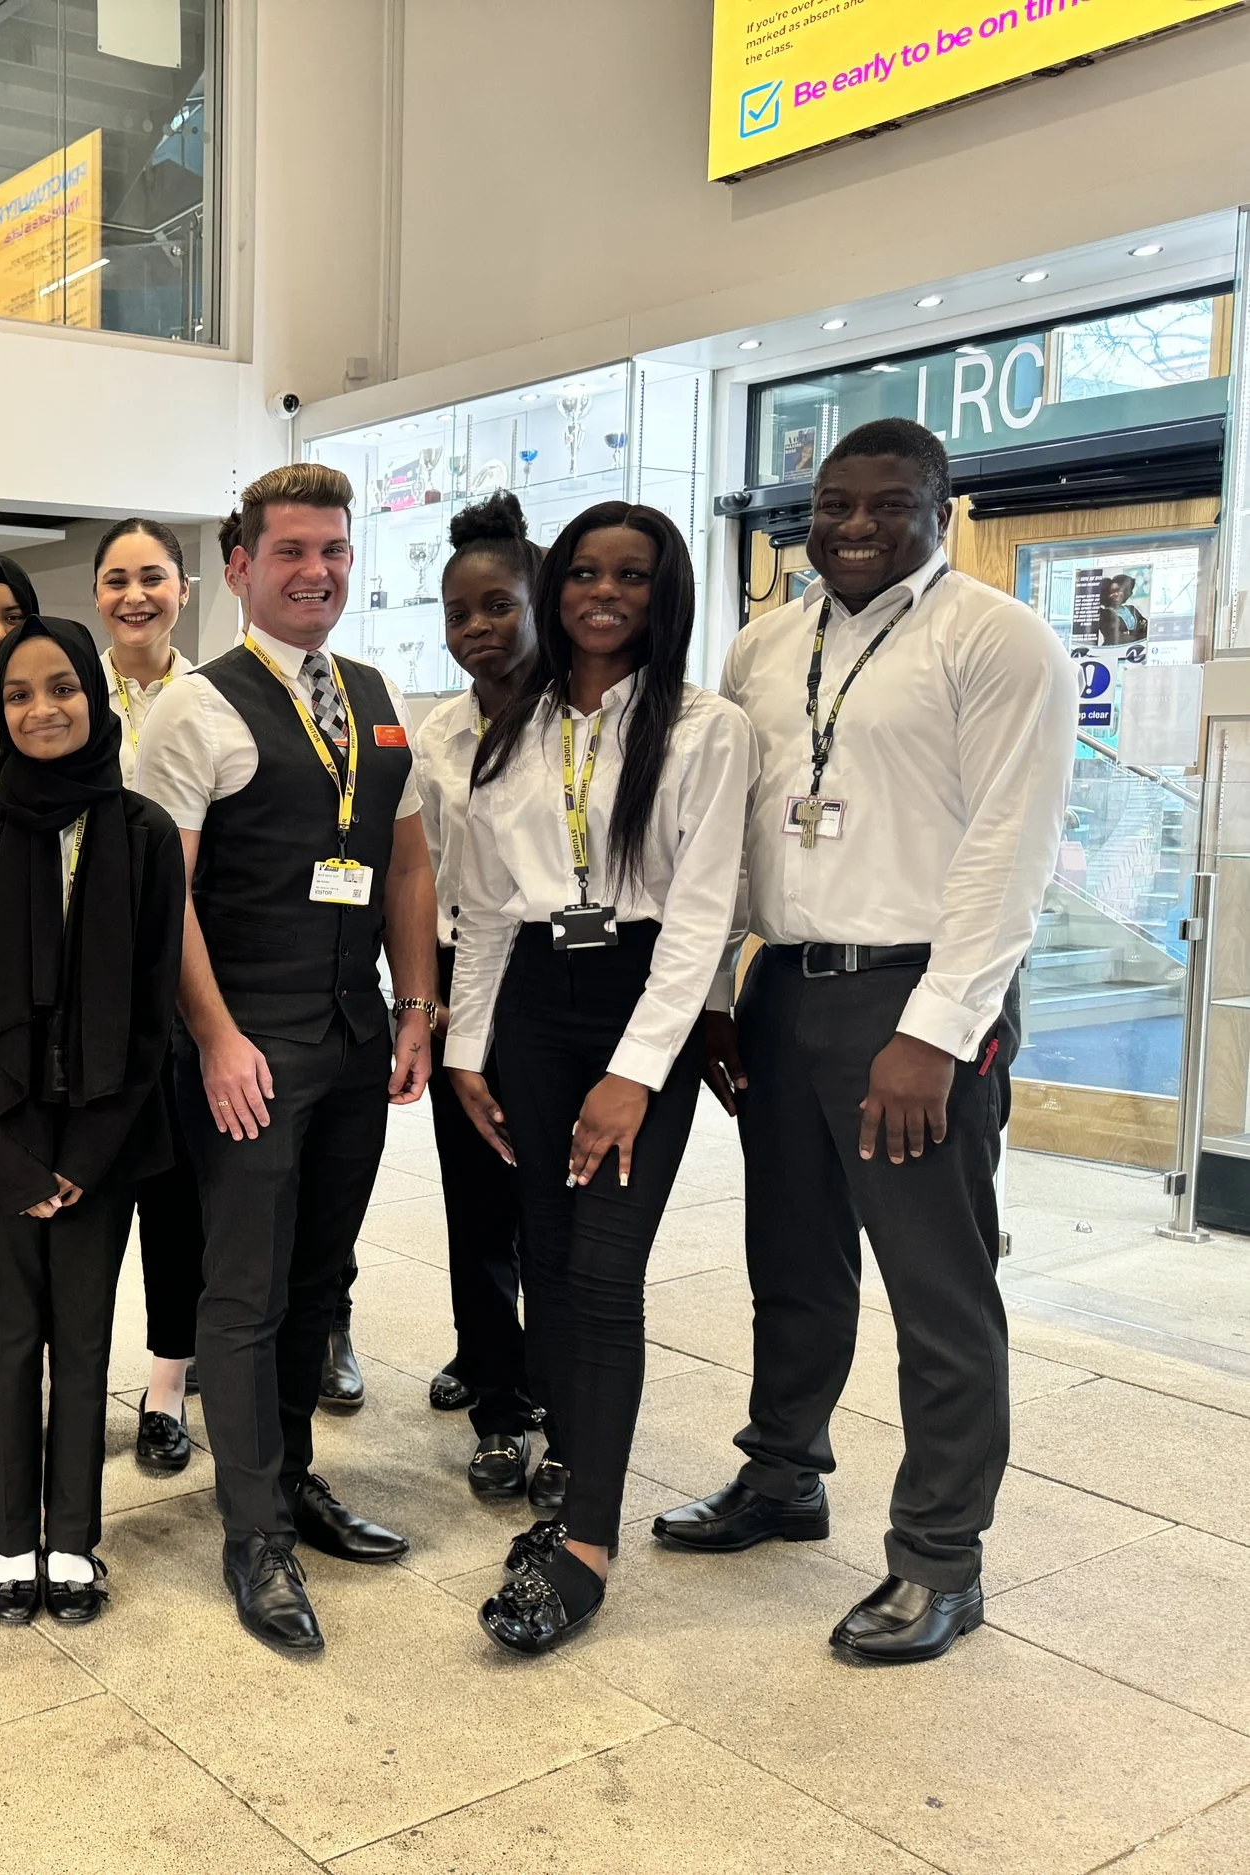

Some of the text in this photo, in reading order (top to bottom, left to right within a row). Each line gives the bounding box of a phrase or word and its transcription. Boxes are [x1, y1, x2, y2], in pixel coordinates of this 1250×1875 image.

[746, 0, 814, 34] If you're over
[746, 25, 786, 49] marked
[789, 21, 800, 32] as
[803, 4, 840, 27] absent
[745, 42, 793, 65] the class.
[794, 80, 827, 107] Be
[832, 52, 897, 92] early
[900, 42, 930, 67] to
[936, 26, 973, 56] be
[979, 9, 1018, 40] on
[917, 342, 1044, 441] LRC
[252, 645, 272, 667] VISITOR
[853, 650, 872, 673] STAFF
[305, 718, 321, 743] VISITOR
[1087, 710, 1110, 719] clear
[563, 735, 571, 768] STUDENT
[578, 778, 589, 814] STUDENT
[74, 815, 85, 852] STUDENT
[570, 828, 583, 865] STUDENT
